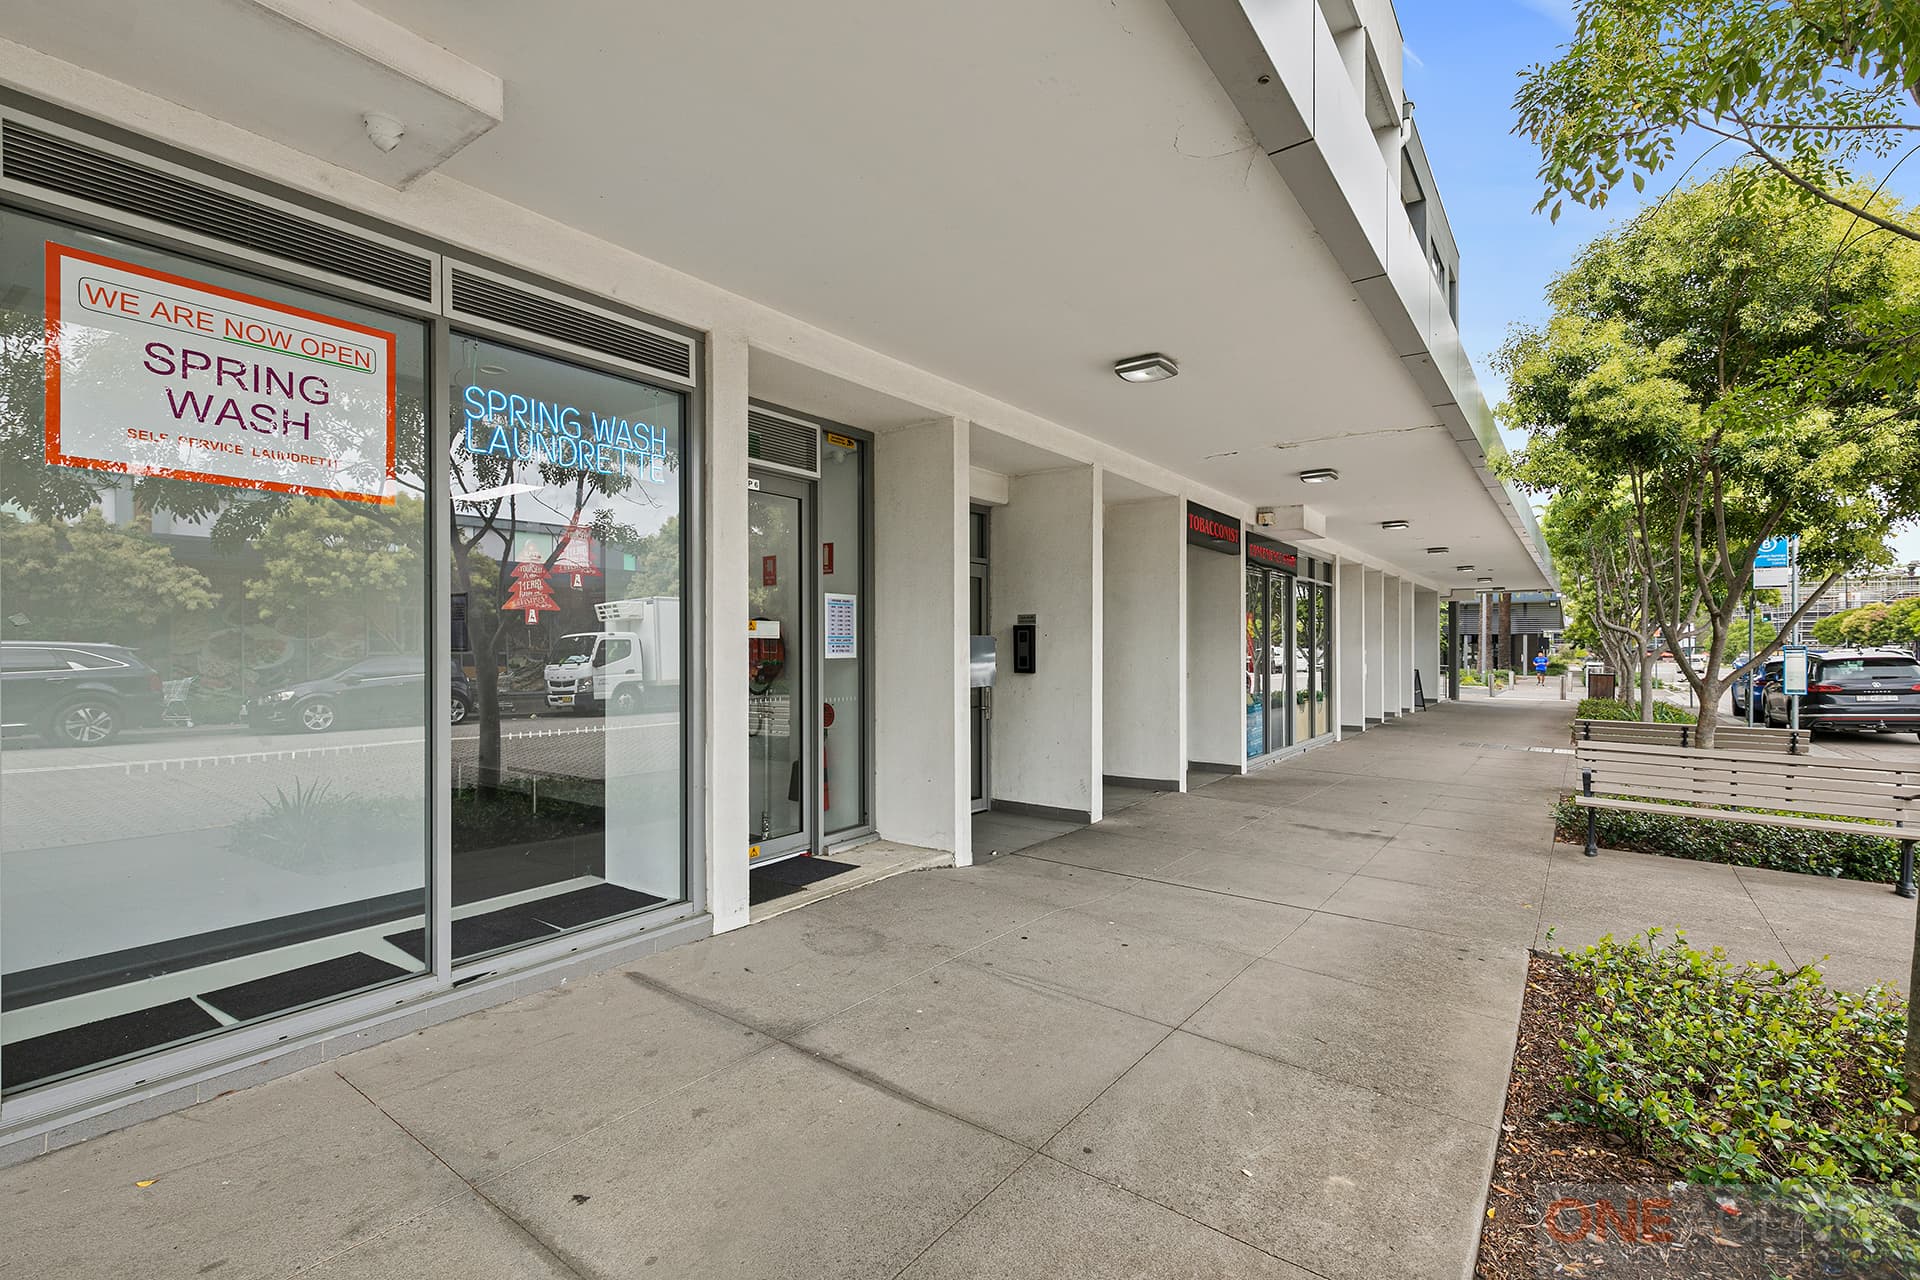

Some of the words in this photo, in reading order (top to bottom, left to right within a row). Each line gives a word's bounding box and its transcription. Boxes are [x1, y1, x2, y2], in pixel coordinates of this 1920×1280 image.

[85, 282, 140, 316] WE
[151, 301, 214, 333] ARE
[224, 318, 293, 351] NOW
[301, 336, 371, 369] OPEN
[143, 341, 330, 405] SPRING
[165, 386, 311, 441] WASH
[464, 385, 582, 439] SPRING
[591, 411, 667, 457] WASH
[177, 435, 244, 455] SERVICE
[252, 447, 337, 468] LAUNDRETT
[465, 418, 666, 484] LAUNDRETTE
[1188, 514, 1238, 543] TOBACCONIST
